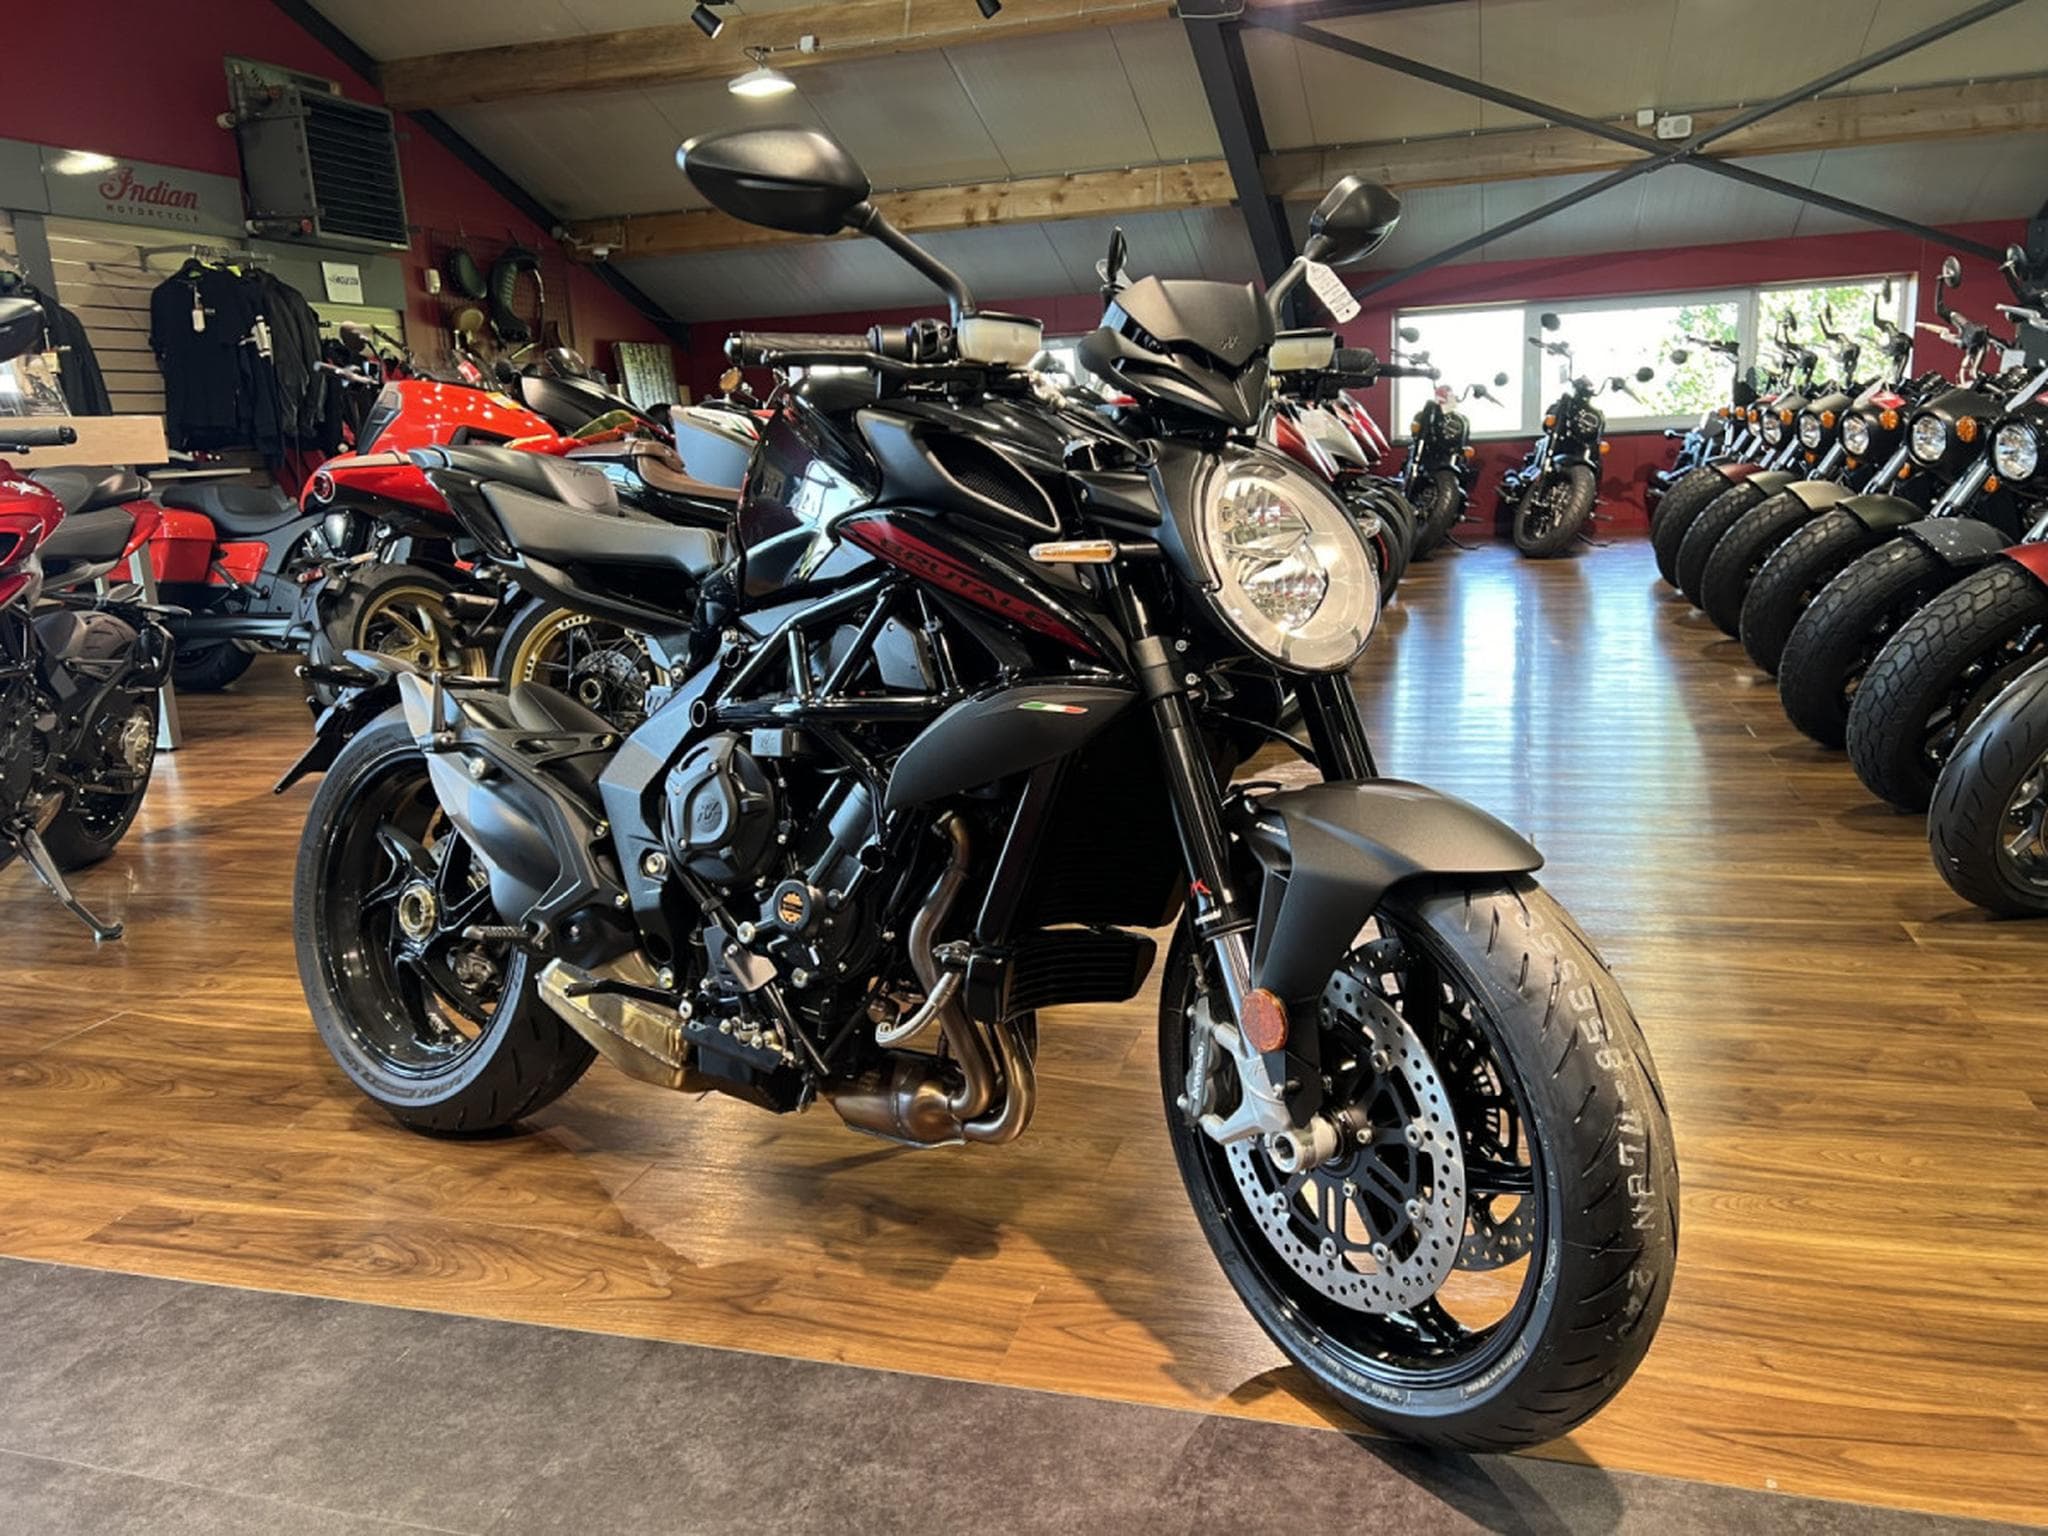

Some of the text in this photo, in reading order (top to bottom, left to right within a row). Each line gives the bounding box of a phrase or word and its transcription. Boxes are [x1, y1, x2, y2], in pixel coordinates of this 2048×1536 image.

[99, 167, 198, 210] Indian
[105, 203, 198, 223] MOTORCYCLE
[879, 537, 1051, 627] BRUTALE
